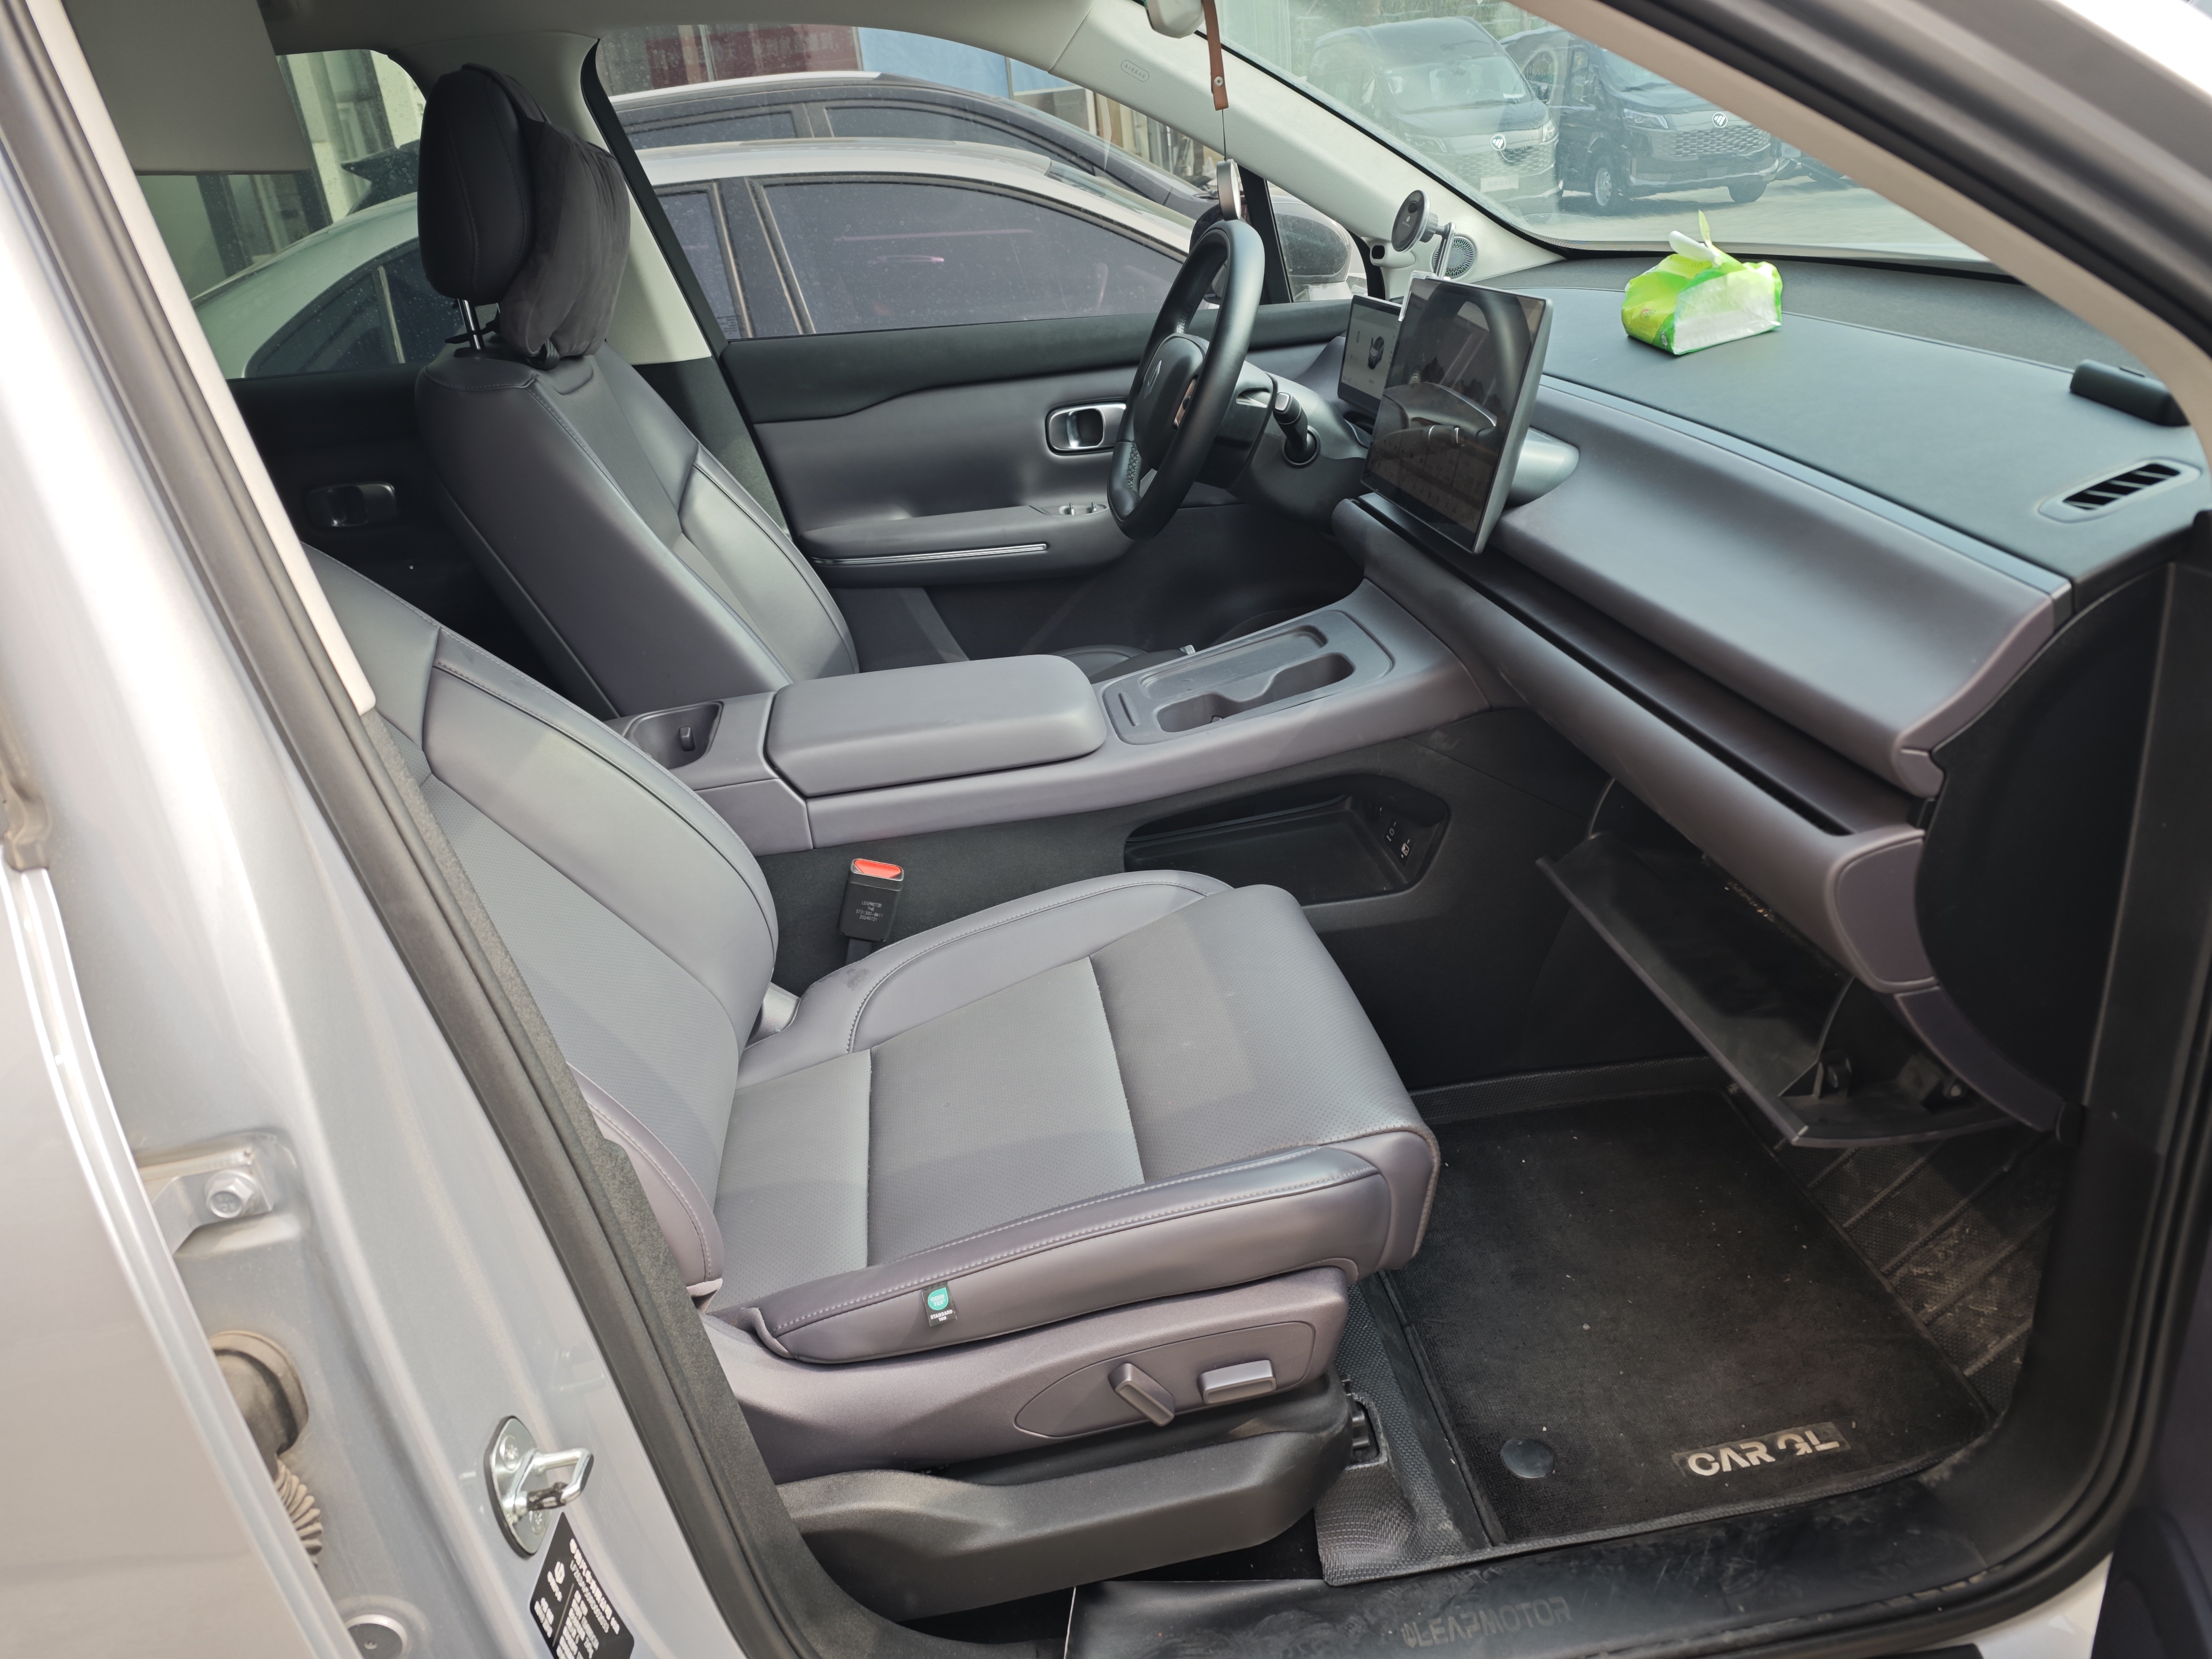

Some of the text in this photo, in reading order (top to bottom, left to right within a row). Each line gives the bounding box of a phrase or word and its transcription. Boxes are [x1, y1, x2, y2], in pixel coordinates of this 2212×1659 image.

[1124, 64, 1145, 78] AIRBAG
[930, 1309, 953, 1319] STANDARD
[1688, 1441, 1776, 1476] CAR
[1412, 1596, 1574, 1648] LEAPMOTOR
